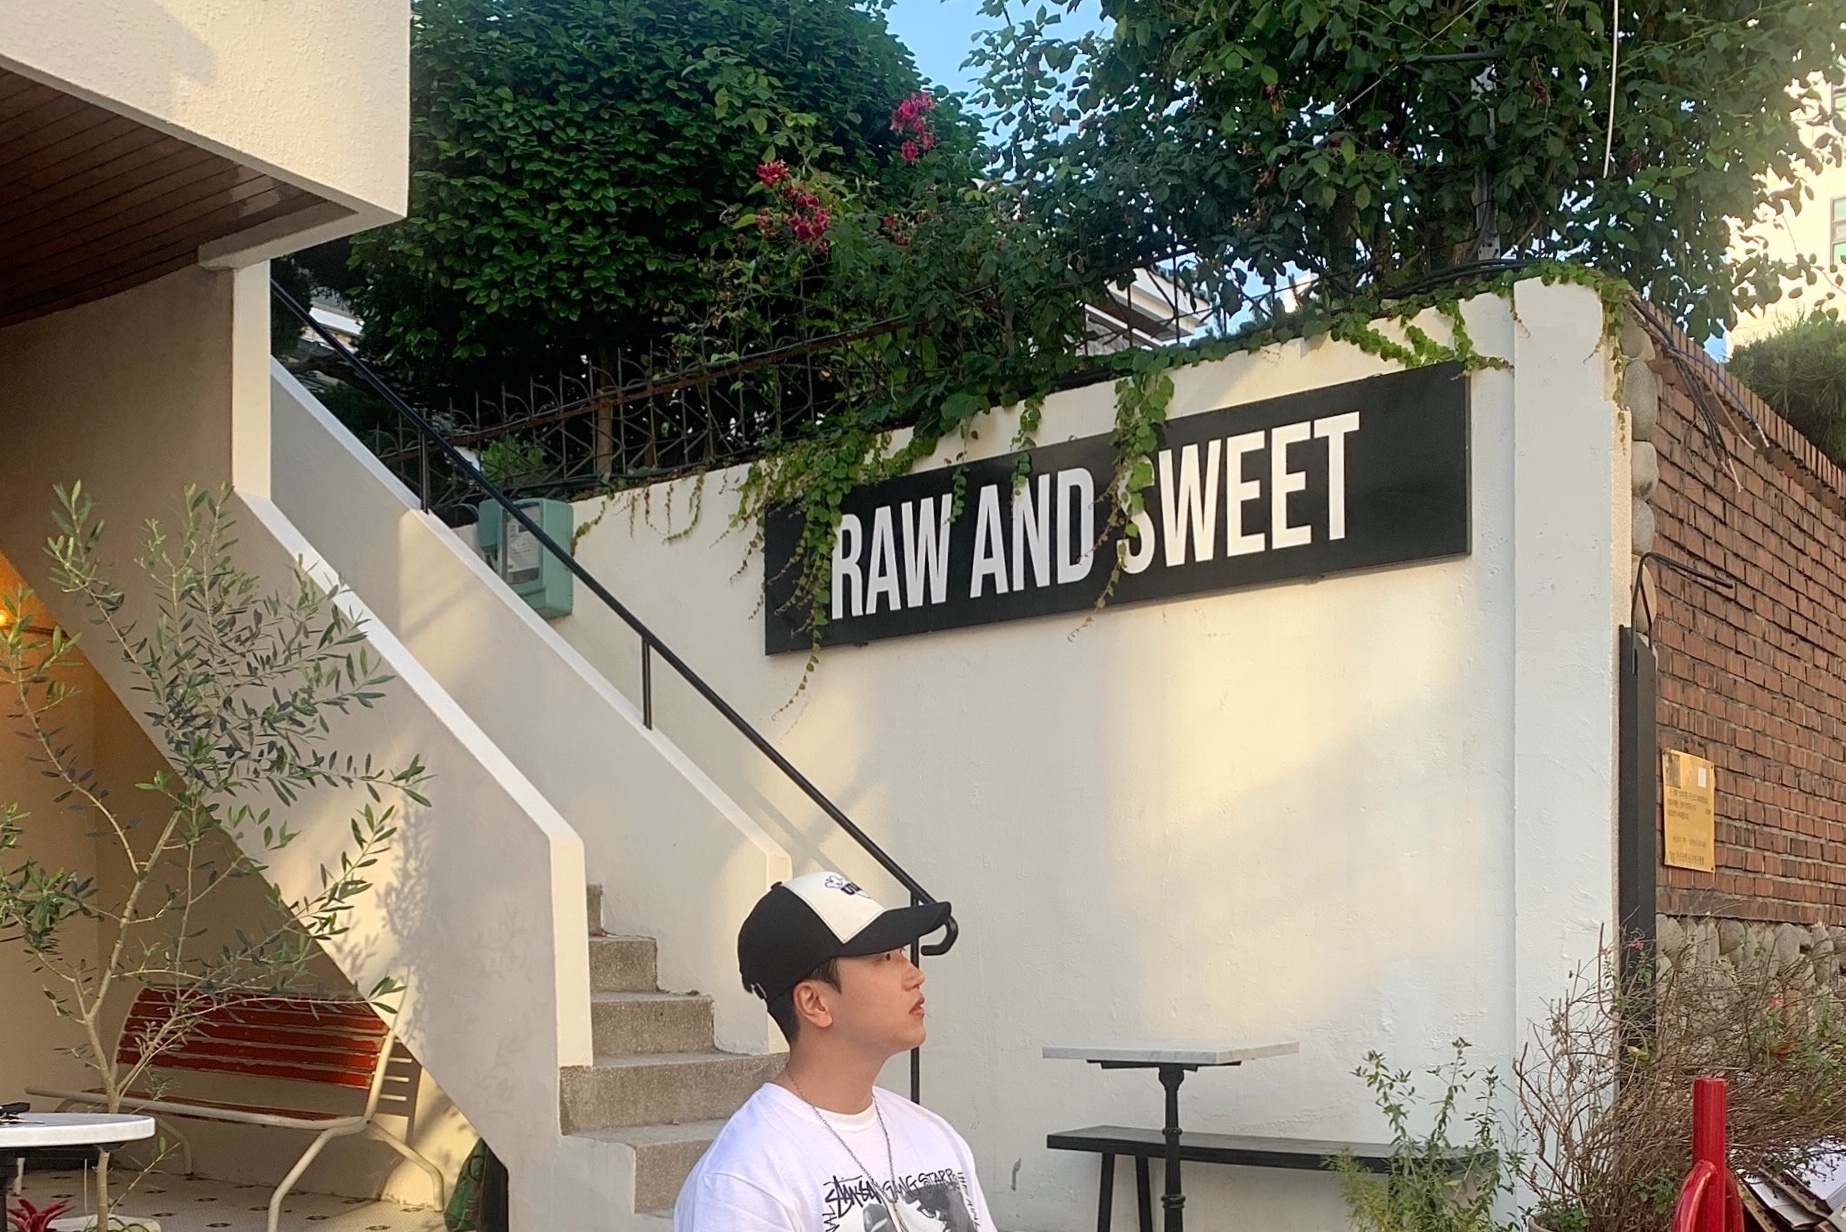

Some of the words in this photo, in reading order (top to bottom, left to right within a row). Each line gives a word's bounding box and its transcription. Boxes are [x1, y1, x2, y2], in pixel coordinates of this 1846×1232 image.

[832, 493, 953, 620] RAW
[970, 467, 1095, 598] AND
[1116, 411, 1360, 575] SWEET
